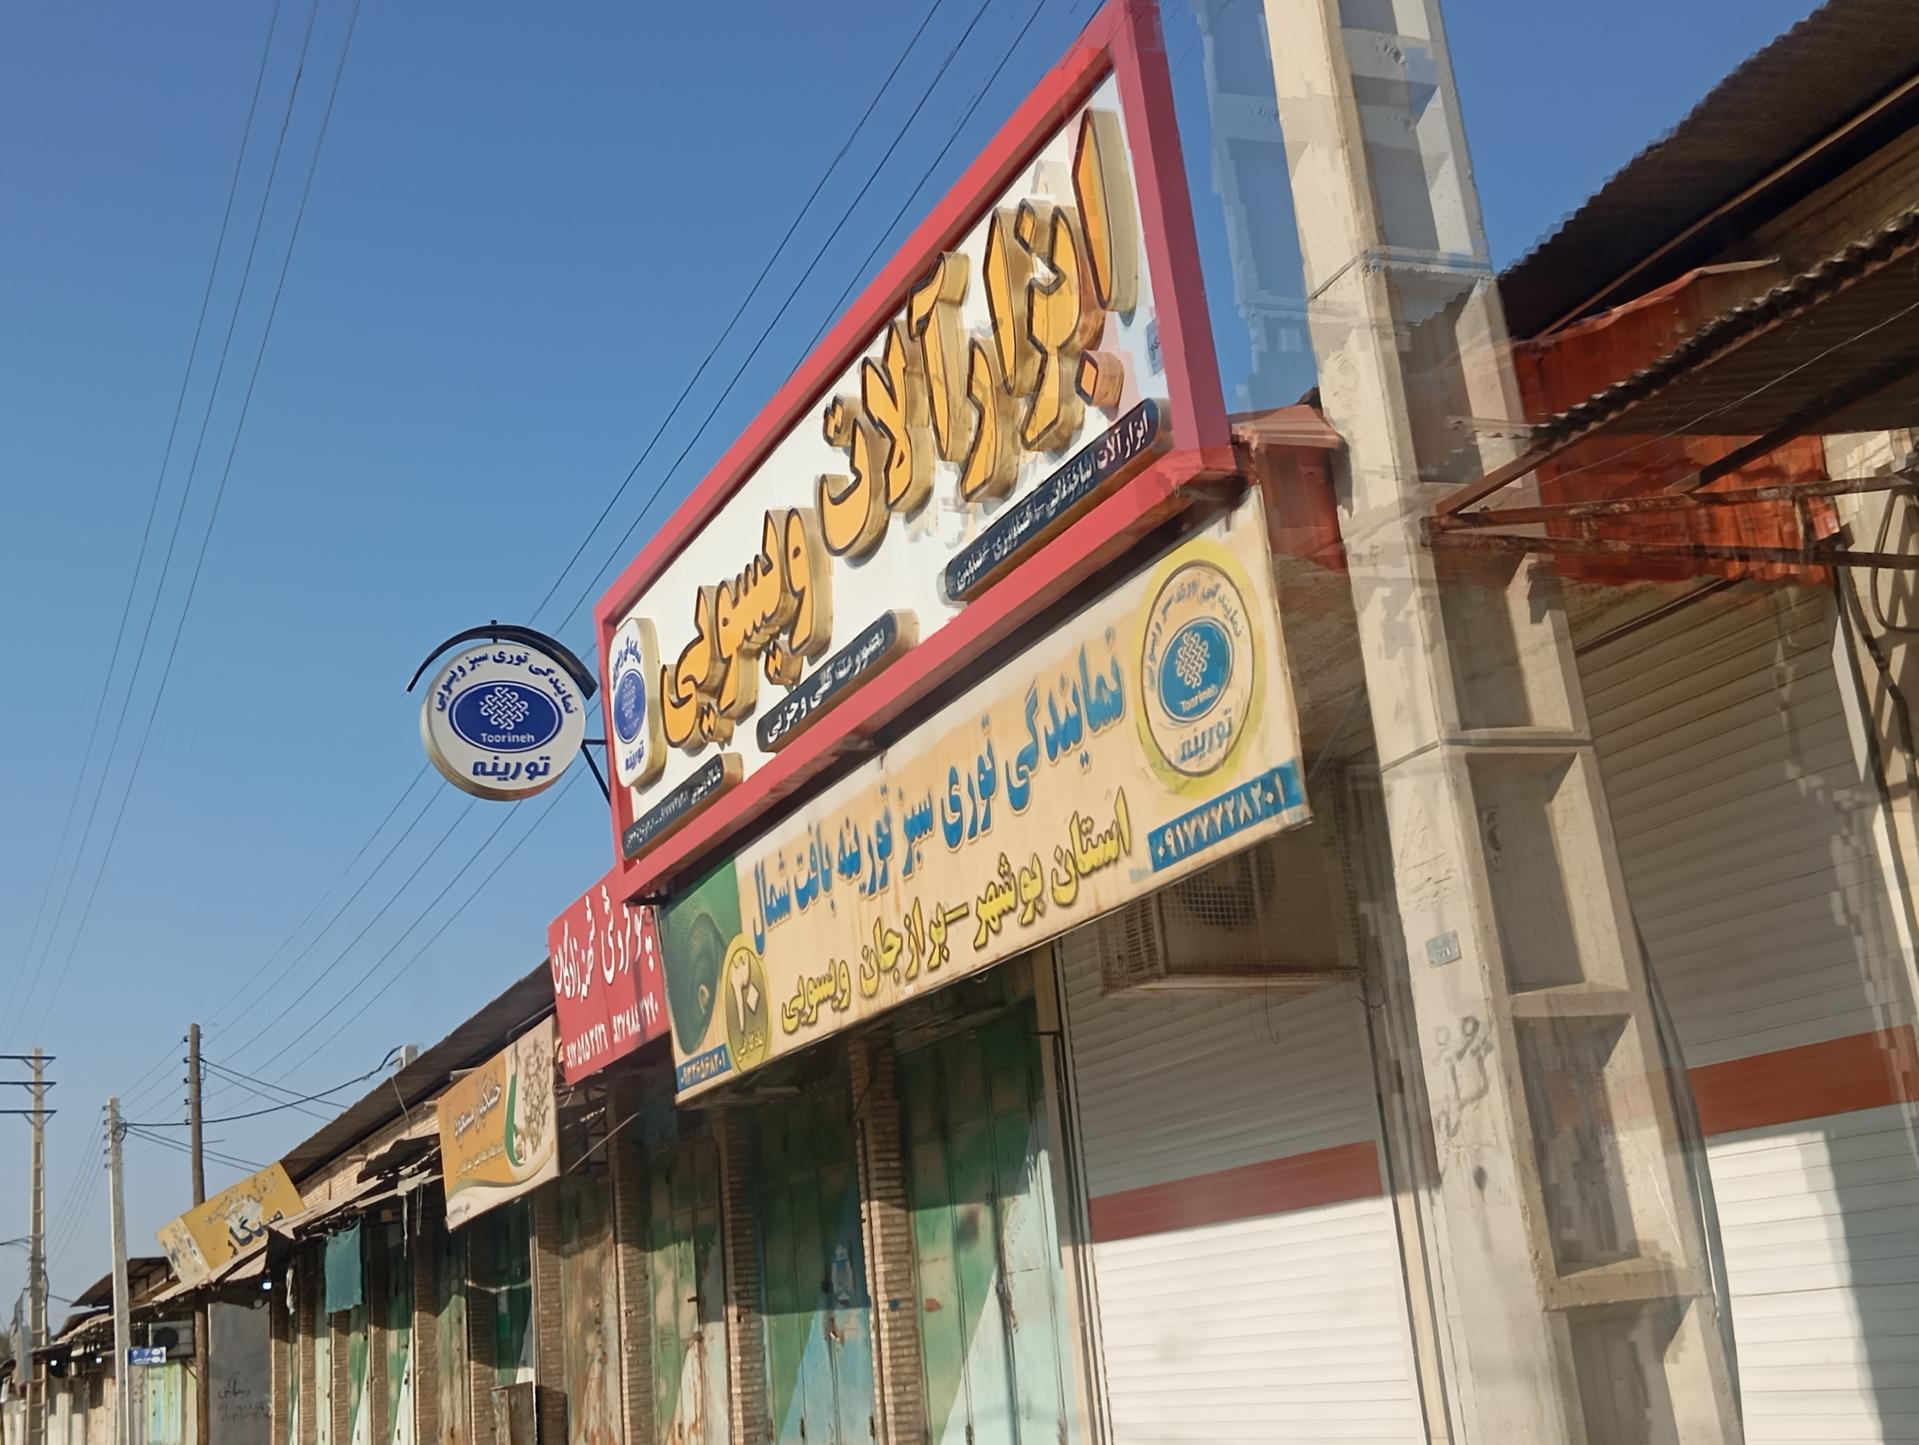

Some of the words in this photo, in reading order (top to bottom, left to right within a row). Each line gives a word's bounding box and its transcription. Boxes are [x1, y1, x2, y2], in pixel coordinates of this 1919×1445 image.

[465, 653, 489, 671] سبز
[492, 651, 530, 666] توری
[528, 664, 578, 714] نمایندگی
[472, 755, 551, 781] تورینه
[481, 732, 535, 743] Toorineh
[1004, 627, 1127, 812] نمایندگی
[1177, 707, 1233, 764] تورینه
[941, 711, 998, 850] توری
[794, 820, 834, 917] بافت
[837, 784, 895, 896] تورینه
[901, 786, 935, 877] سبز
[1050, 786, 1132, 906] استان
[752, 852, 791, 955] شمال
[859, 896, 951, 999] برازجان
[973, 852, 1046, 951] بوشهر
